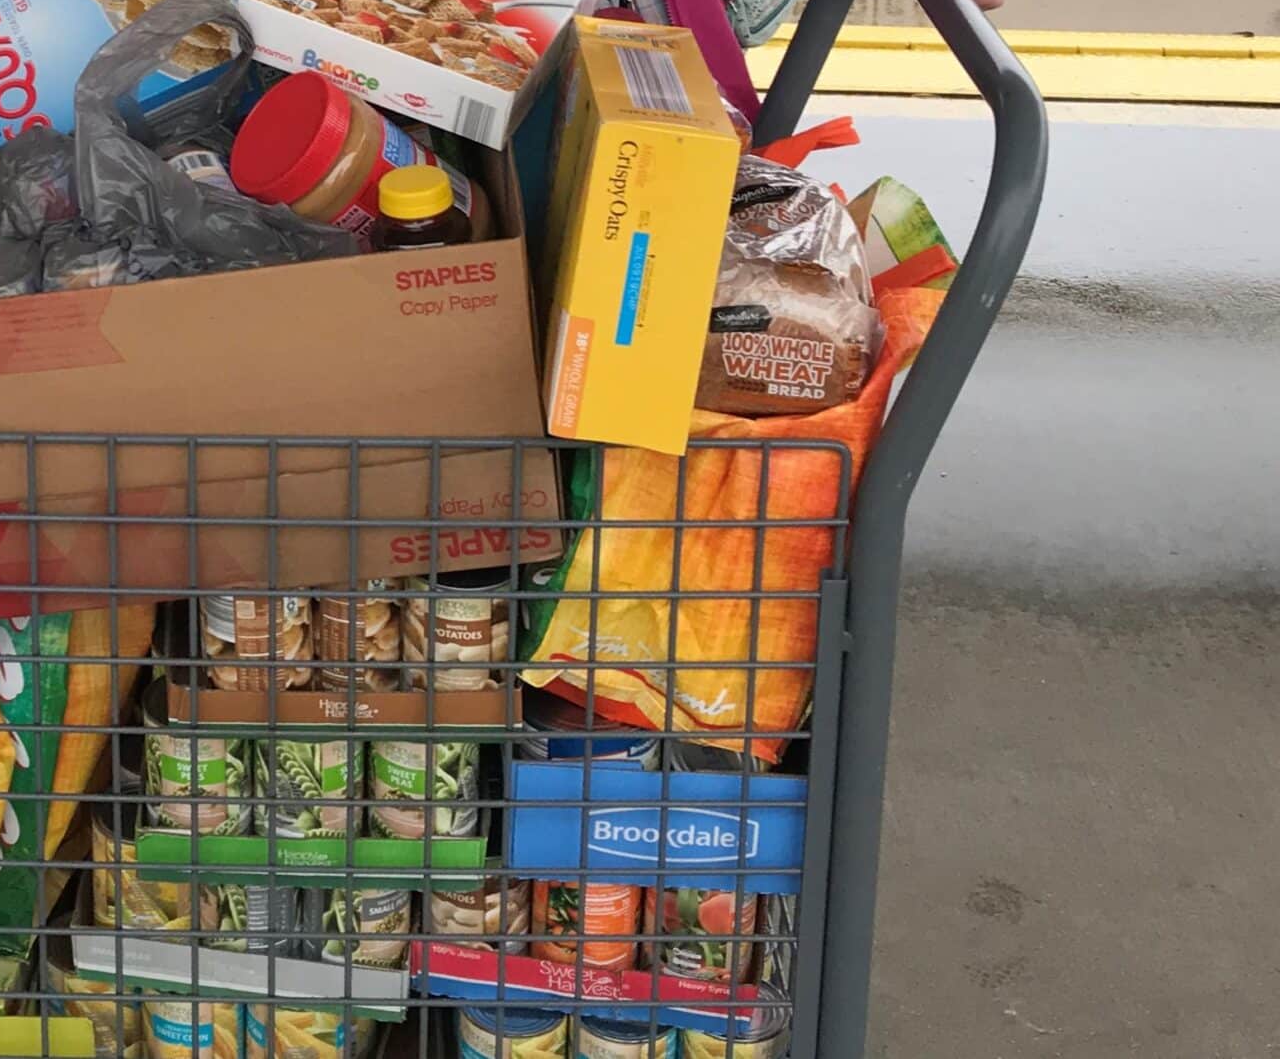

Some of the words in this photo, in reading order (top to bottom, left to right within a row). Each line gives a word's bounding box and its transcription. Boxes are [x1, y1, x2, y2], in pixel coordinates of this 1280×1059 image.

[302, 49, 380, 91] Balance
[608, 140, 639, 200] Crispy
[605, 200, 629, 241] Oats
[396, 262, 496, 290] STAPLES
[400, 300, 444, 316] Copy
[448, 293, 499, 312] Paper
[714, 309, 767, 322] Signature
[722, 332, 768, 356] 100%
[770, 336, 834, 365] WHOLE
[570, 354, 585, 389] WHOLE
[722, 354, 832, 387] WHEAT
[767, 383, 825, 400] BREAD
[562, 394, 578, 428] GRAIN
[425, 495, 484, 517] Papr
[319, 698, 357, 712] Happ
[325, 707, 374, 719] Harest
[176, 763, 208, 772] SWET
[181, 772, 206, 781] PES
[387, 764, 416, 781] SWEET
[390, 776, 414, 788] PEAS
[431, 945, 456, 956] 100%
[539, 959, 598, 981] Sweet
[548, 976, 621, 999] Havest
[679, 981, 707, 993] Heavy
[708, 985, 730, 996] Syru
